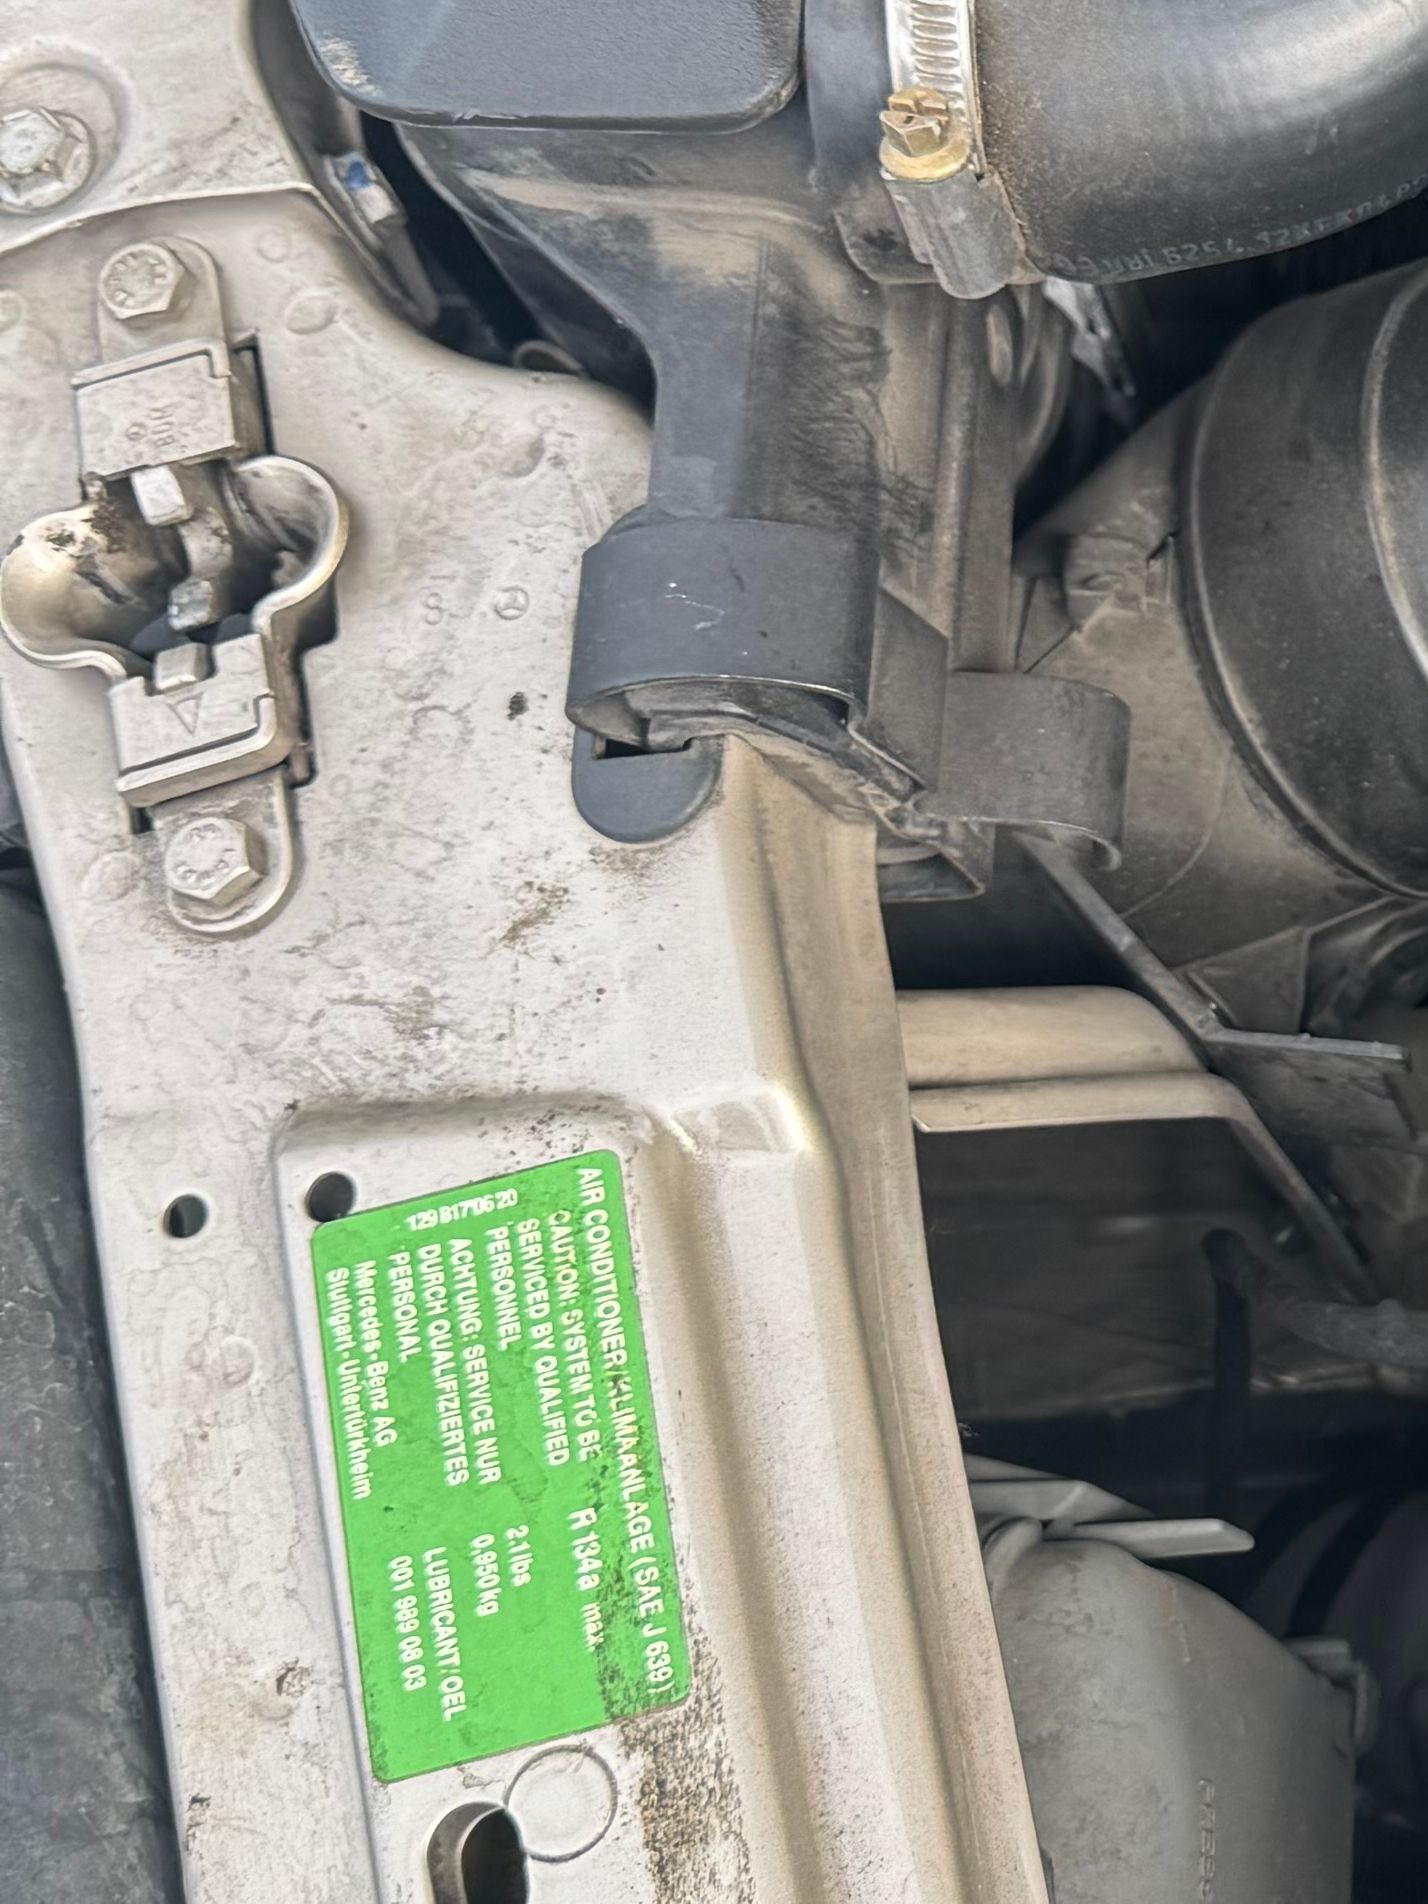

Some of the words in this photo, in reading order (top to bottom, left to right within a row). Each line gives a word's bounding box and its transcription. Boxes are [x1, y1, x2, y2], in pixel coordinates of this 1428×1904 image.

[405, 1208, 438, 1231] 129
[495, 1188, 518, 1209] 20
[416, 1243, 448, 1325] DURCH
[448, 1238, 483, 1342] ACHTUNG:
[484, 1225, 522, 1352] PERSONNEL
[516, 1218, 550, 1320] SERVICED
[548, 1209, 580, 1307] CAUTION:
[388, 1250, 422, 1364] PERSONAL
[529, 1322, 555, 1352] BY
[324, 1266, 372, 1501] Stuttgart-Untertürkheim
[353, 1260, 390, 1412] Mercedes-Benz
[372, 1416, 398, 1448] AG
[462, 1344, 495, 1436] SERVICE
[560, 1309, 594, 1395] SYSTEM
[426, 1318, 470, 1487] QUALIFIZIERTES
[532, 1355, 570, 1467] QUALIFIED
[569, 1395, 597, 1426] TO
[577, 1168, 606, 1206] AIR
[641, 1623, 667, 1639] J
[473, 1437, 502, 1486] NUR
[576, 1429, 602, 1463] BE
[568, 1507, 598, 1531] R
[388, 1555, 414, 1593] 001
[571, 1531, 602, 1592] 134a
[393, 1594, 420, 1635] 989
[398, 1635, 422, 1664] 08
[401, 1664, 427, 1692] 03
